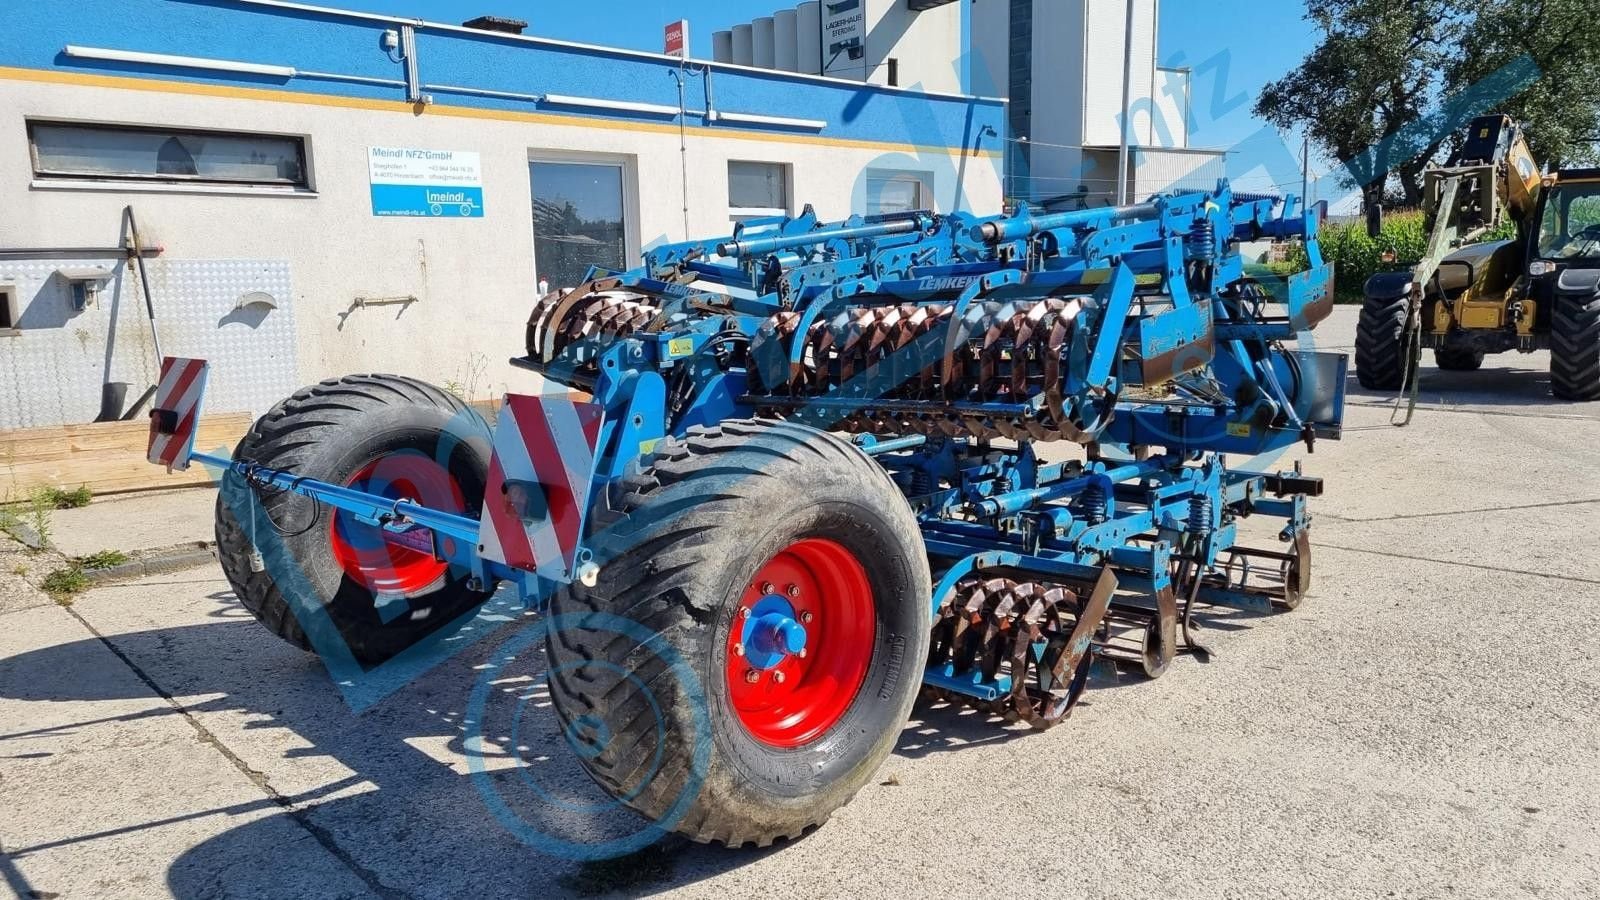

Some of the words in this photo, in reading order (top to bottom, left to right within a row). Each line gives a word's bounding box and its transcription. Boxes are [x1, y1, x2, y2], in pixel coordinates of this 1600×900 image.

[825, 13, 862, 30] LAGERHAUS
[372, 147, 403, 158] Meindl
[430, 191, 465, 202] meindl
